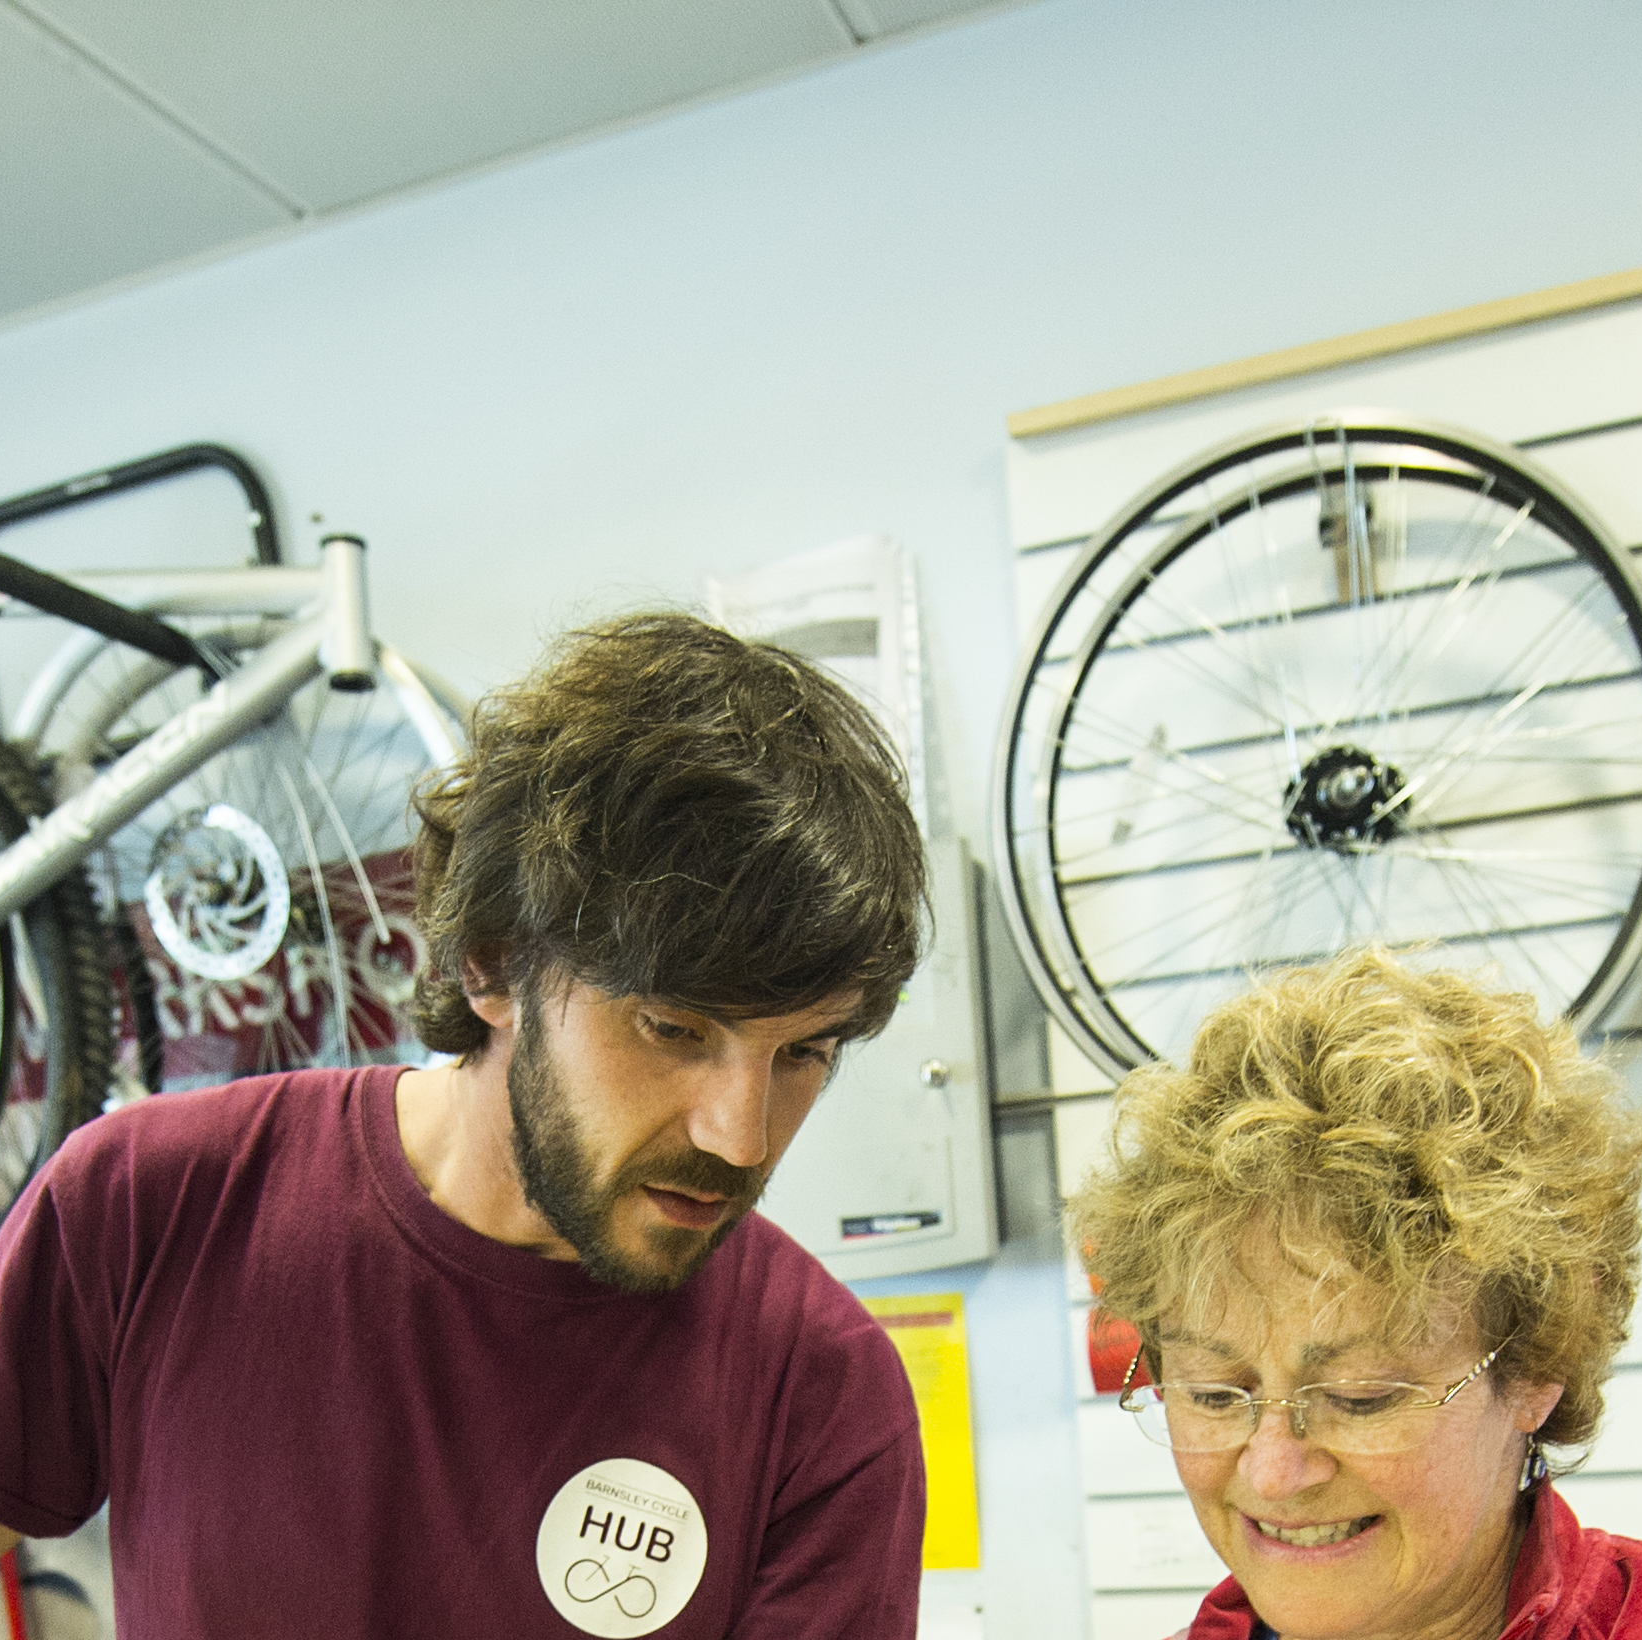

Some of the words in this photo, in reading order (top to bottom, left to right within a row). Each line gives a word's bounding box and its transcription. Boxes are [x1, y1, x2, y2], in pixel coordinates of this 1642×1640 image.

[585, 1478, 650, 1507] BARNSLEY
[651, 1499, 690, 1521] CYCLE
[579, 1504, 675, 1564] HUB
